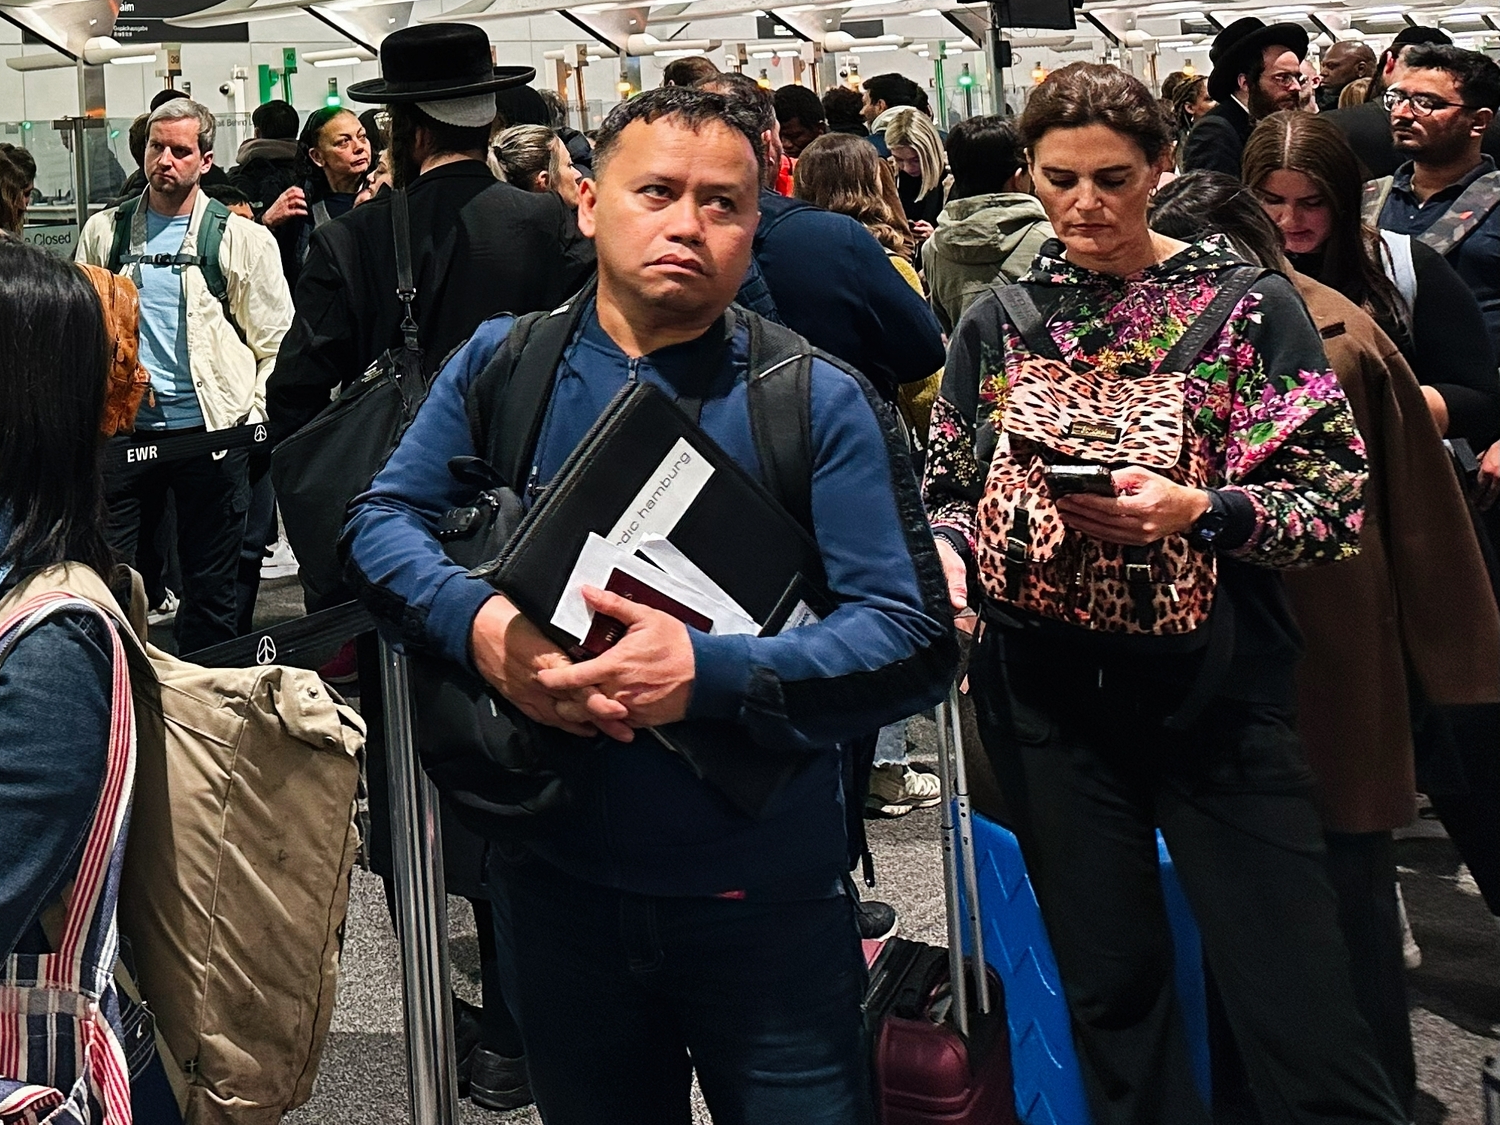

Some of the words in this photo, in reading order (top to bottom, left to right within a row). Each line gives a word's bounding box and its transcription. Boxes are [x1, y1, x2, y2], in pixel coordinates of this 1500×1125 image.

[119, 1, 135, 12] aim
[170, 55, 180, 64] 39
[33, 231, 71, 246] Closed
[127, 445, 158, 463] EWR
[637, 452, 692, 519] hamburg
